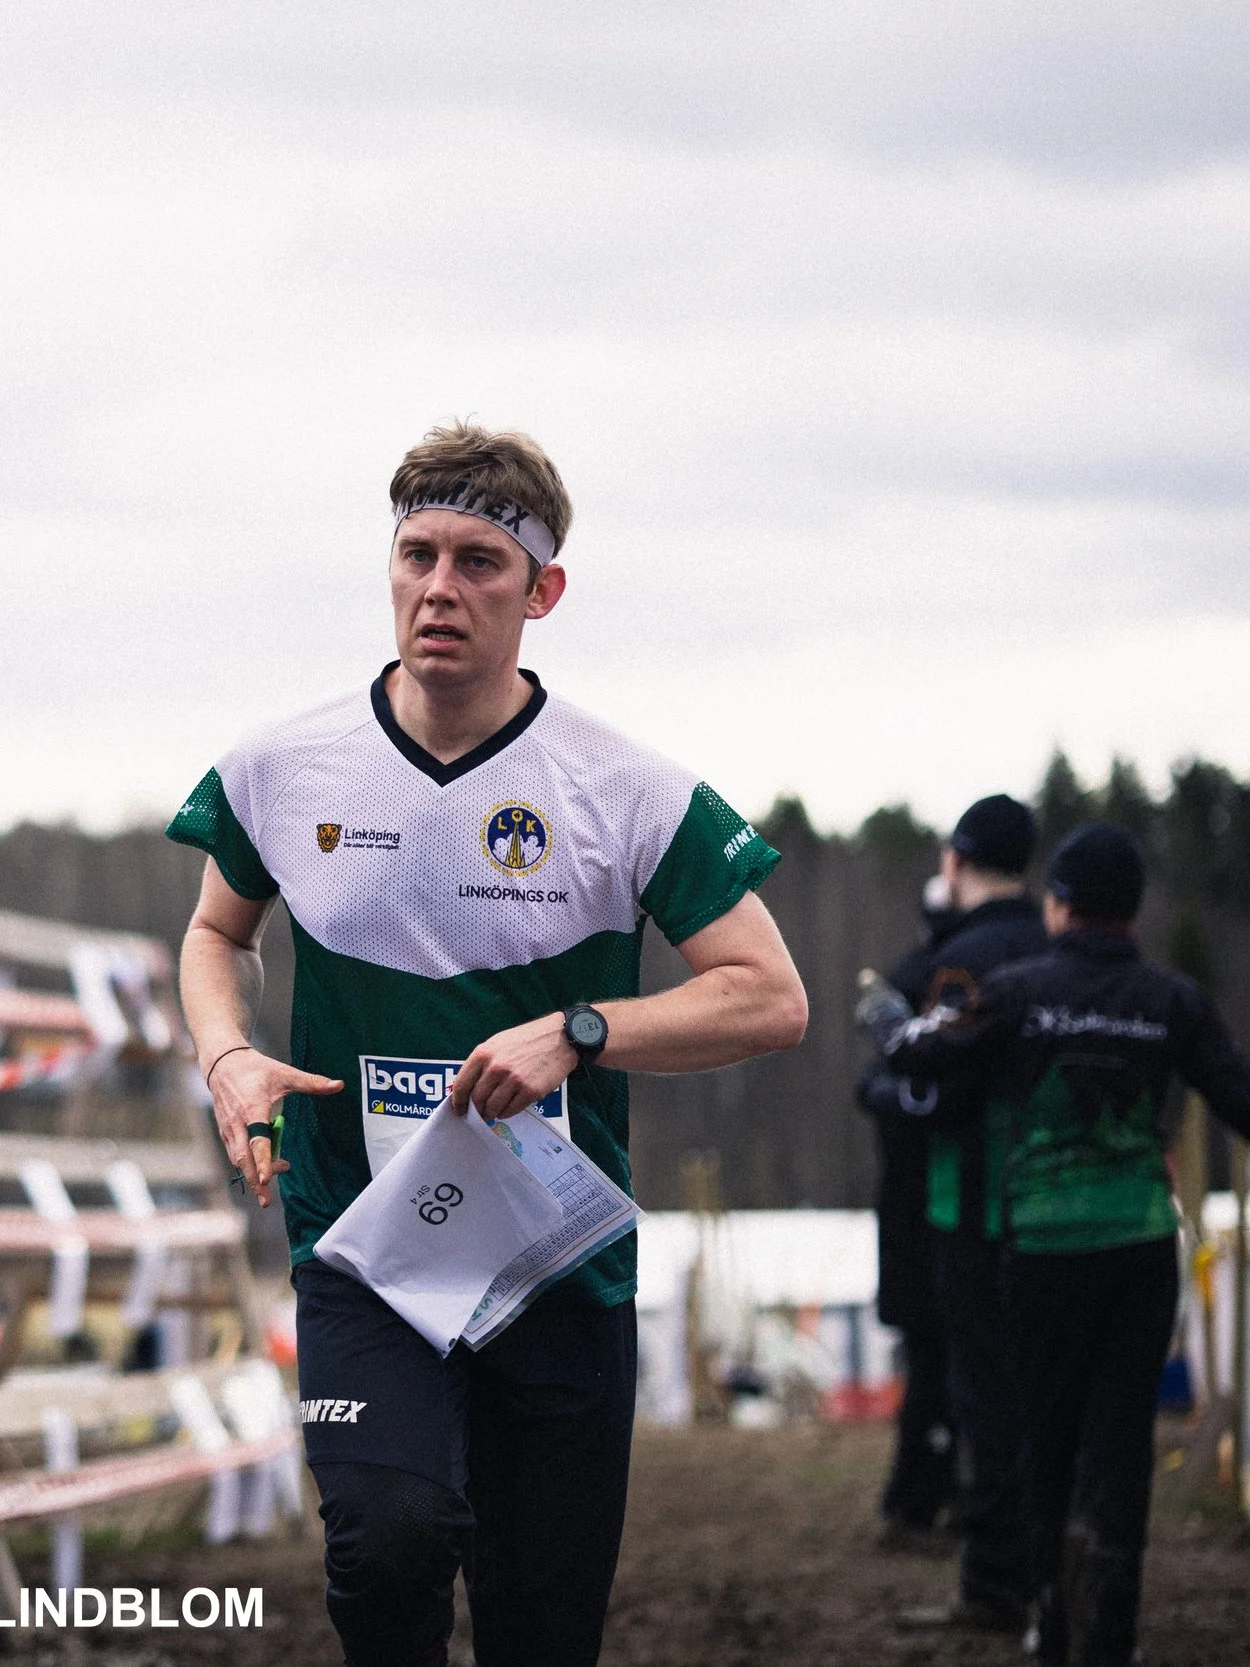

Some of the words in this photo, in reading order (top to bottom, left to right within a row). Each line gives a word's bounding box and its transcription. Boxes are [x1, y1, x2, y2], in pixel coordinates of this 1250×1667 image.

[344, 828, 401, 844] Linköping
[458, 884, 544, 903] LINKÖPINGS
[547, 890, 569, 904] OK
[419, 1183, 464, 1226] 69
